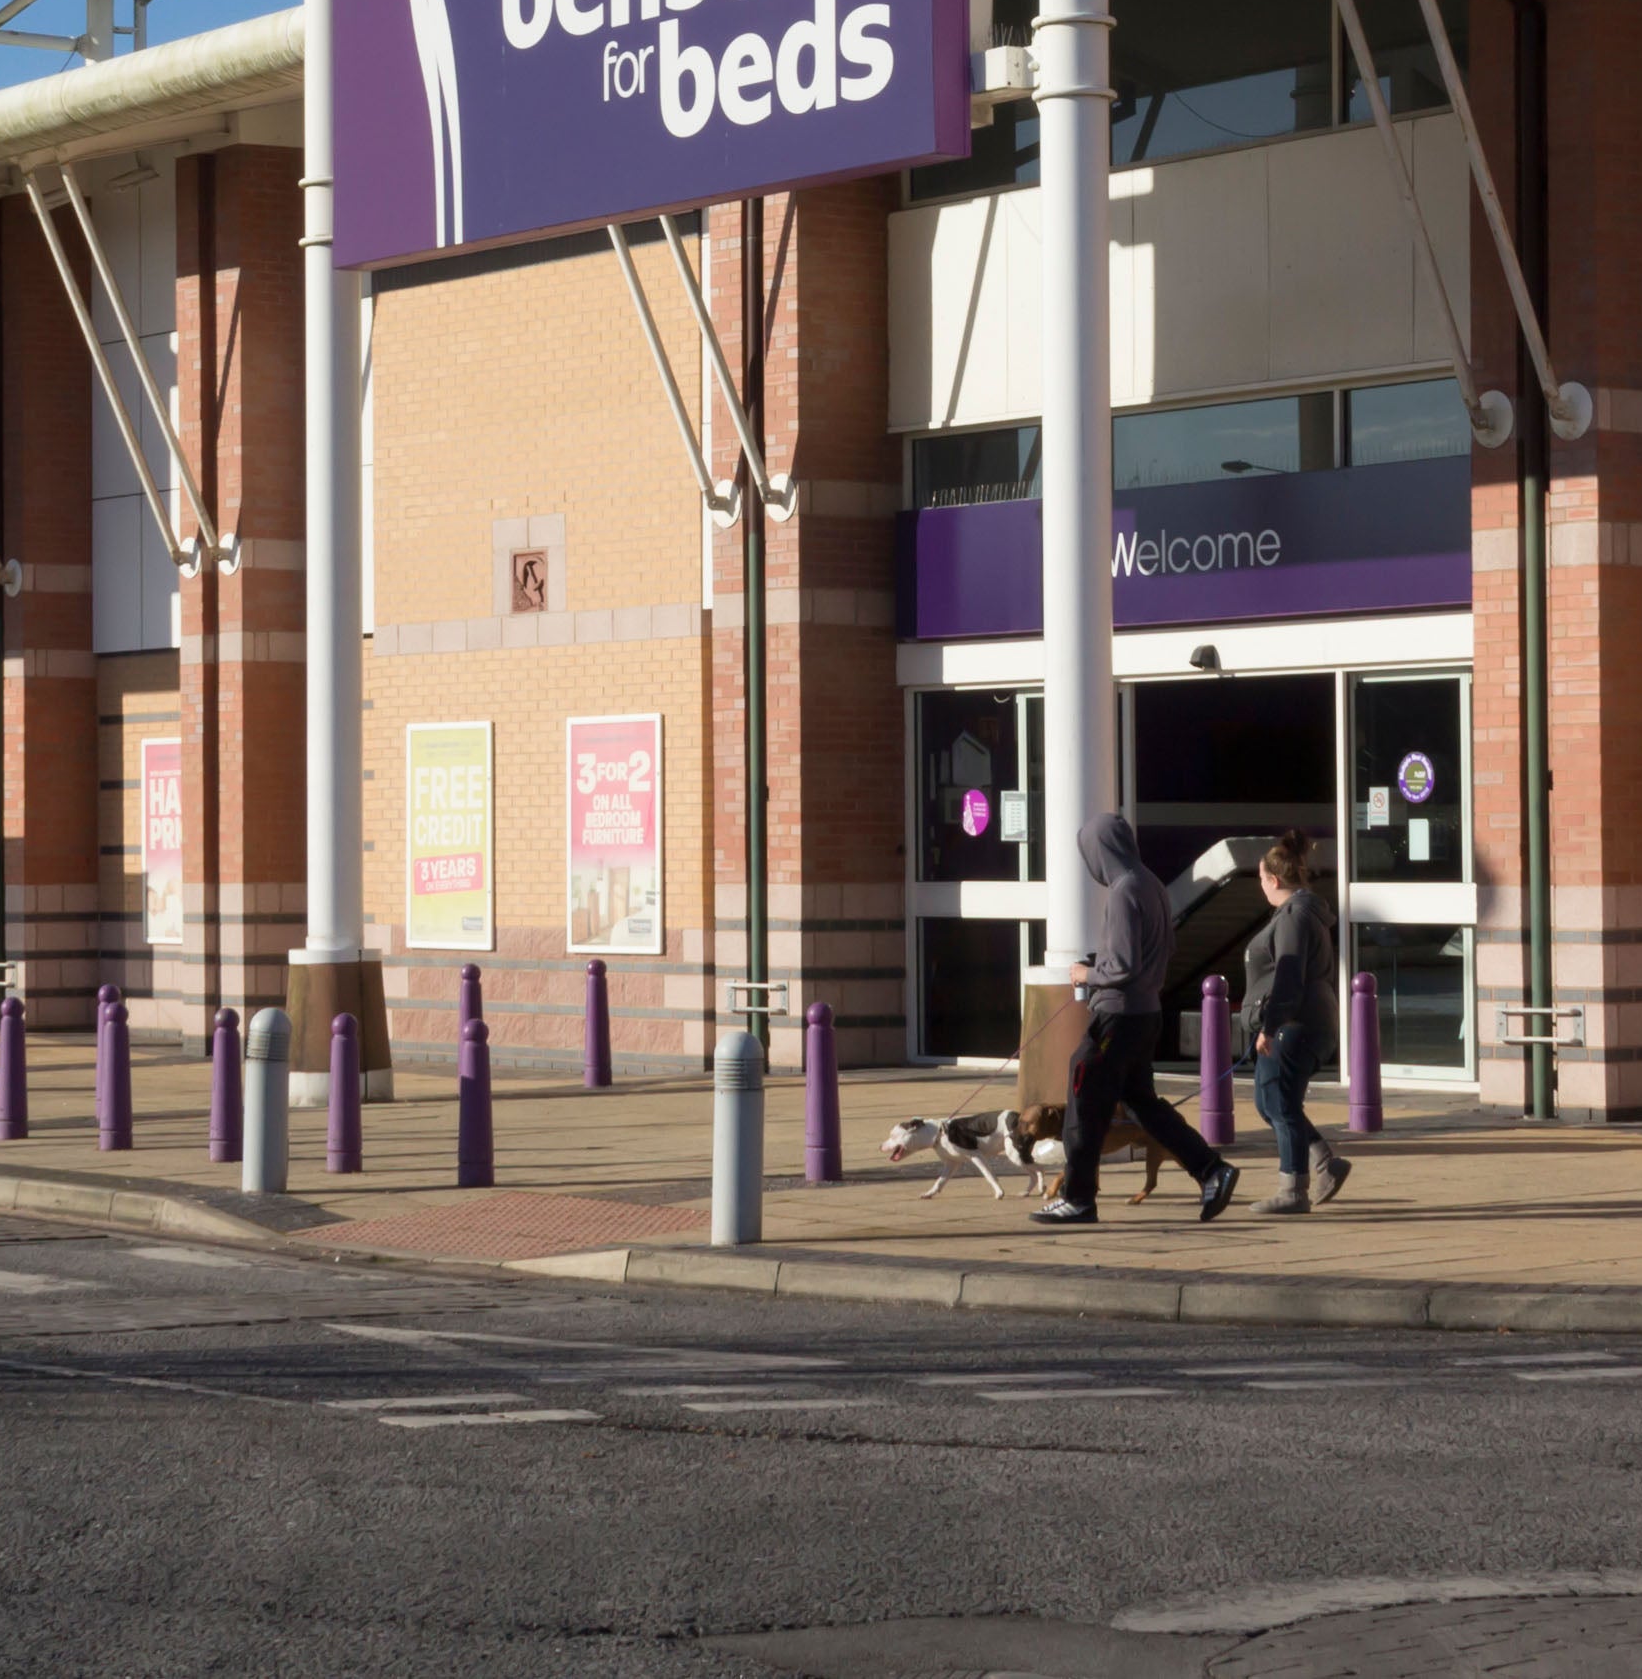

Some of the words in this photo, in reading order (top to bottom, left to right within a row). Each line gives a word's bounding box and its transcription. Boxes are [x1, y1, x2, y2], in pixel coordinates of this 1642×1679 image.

[603, 39, 655, 103] for
[1111, 528, 1282, 578] Welcome
[414, 765, 484, 810] FREE
[576, 752, 597, 795] 3
[597, 761, 628, 783] FOR
[628, 750, 651, 793] 2
[149, 777, 182, 815] HA
[593, 795, 610, 811] ON
[611, 793, 633, 811] ALL
[150, 817, 183, 850] PRI
[414, 813, 484, 848] CREDIT
[582, 828, 644, 845] FURNITURE
[585, 811, 641, 828] BEDROOM
[420, 861, 430, 880] 3
[430, 857, 476, 879] YEARS
